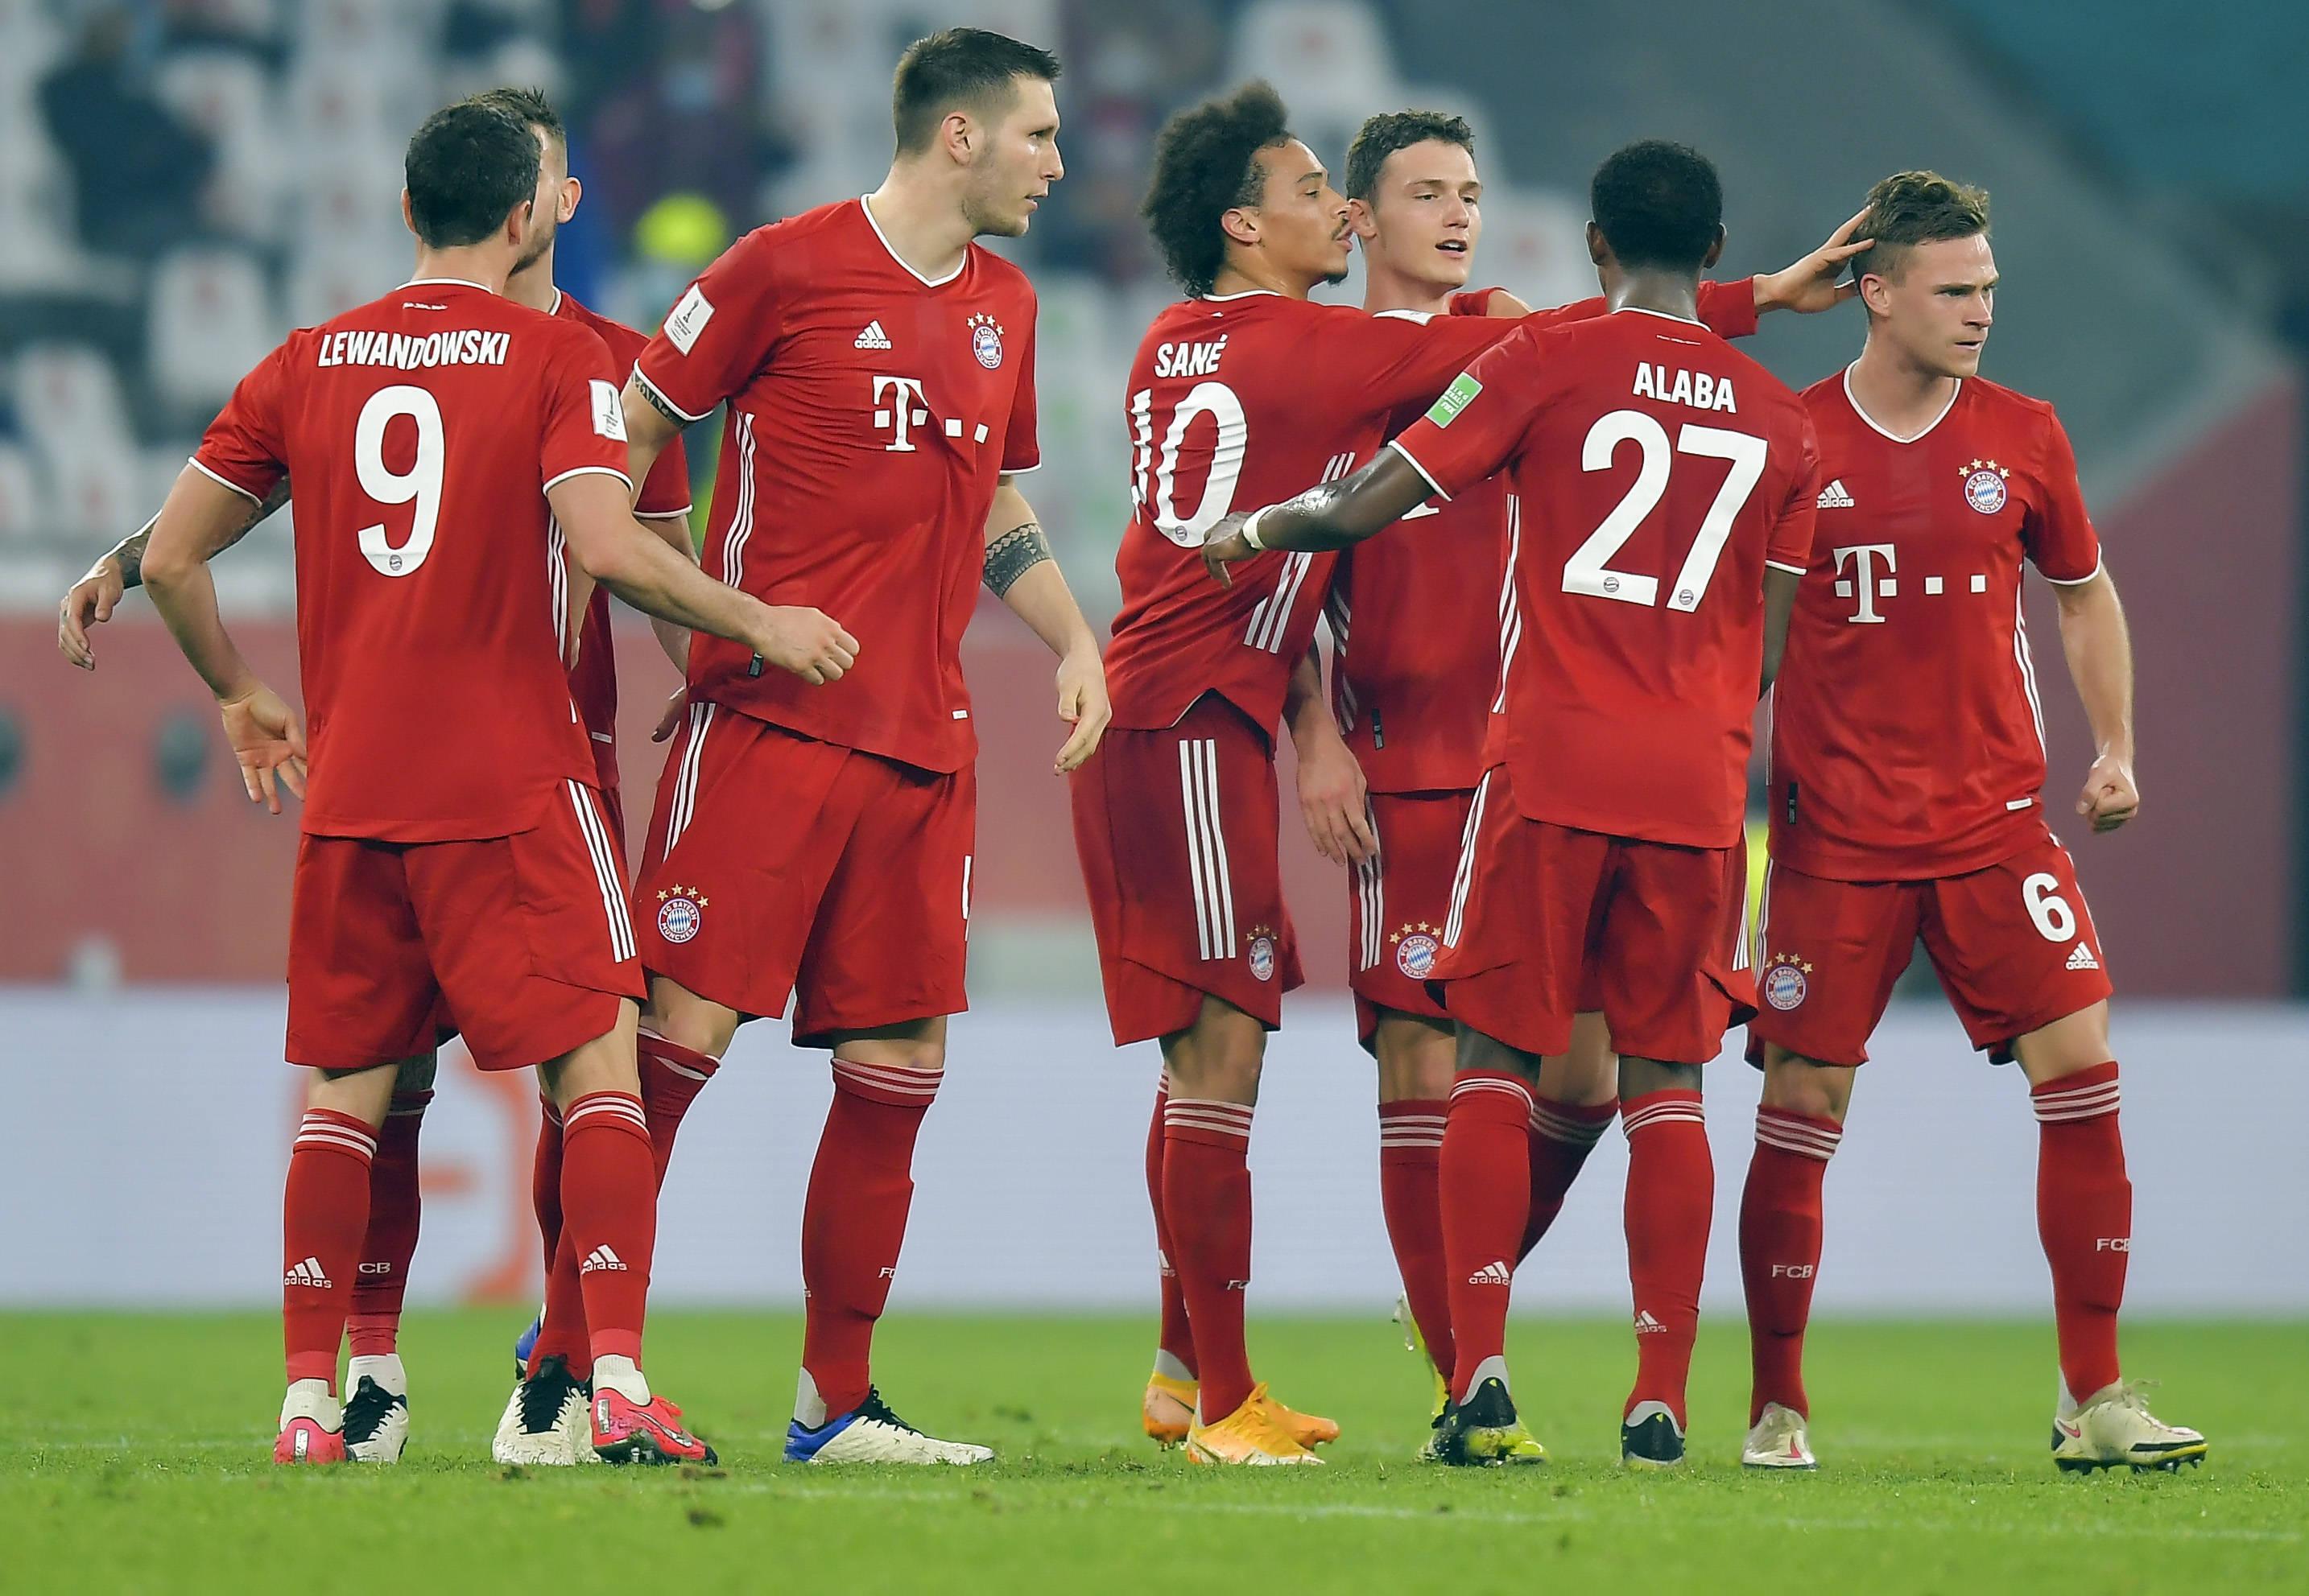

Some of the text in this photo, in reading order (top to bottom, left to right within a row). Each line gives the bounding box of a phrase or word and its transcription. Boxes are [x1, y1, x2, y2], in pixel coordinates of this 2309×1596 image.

[317, 328, 510, 369] LEWANDOWSKI
[854, 337, 892, 349] adidas
[1154, 334, 1229, 378] SANÉ
[1632, 361, 1737, 414] ALABA
[354, 384, 446, 578] 9
[1130, 381, 1248, 549] 10
[1561, 409, 1769, 612] 27
[2022, 872, 2077, 942] 6
[284, 1275, 333, 1289] adidas
[358, 1262, 391, 1274] CB
[1772, 1264, 1814, 1279] FCB
